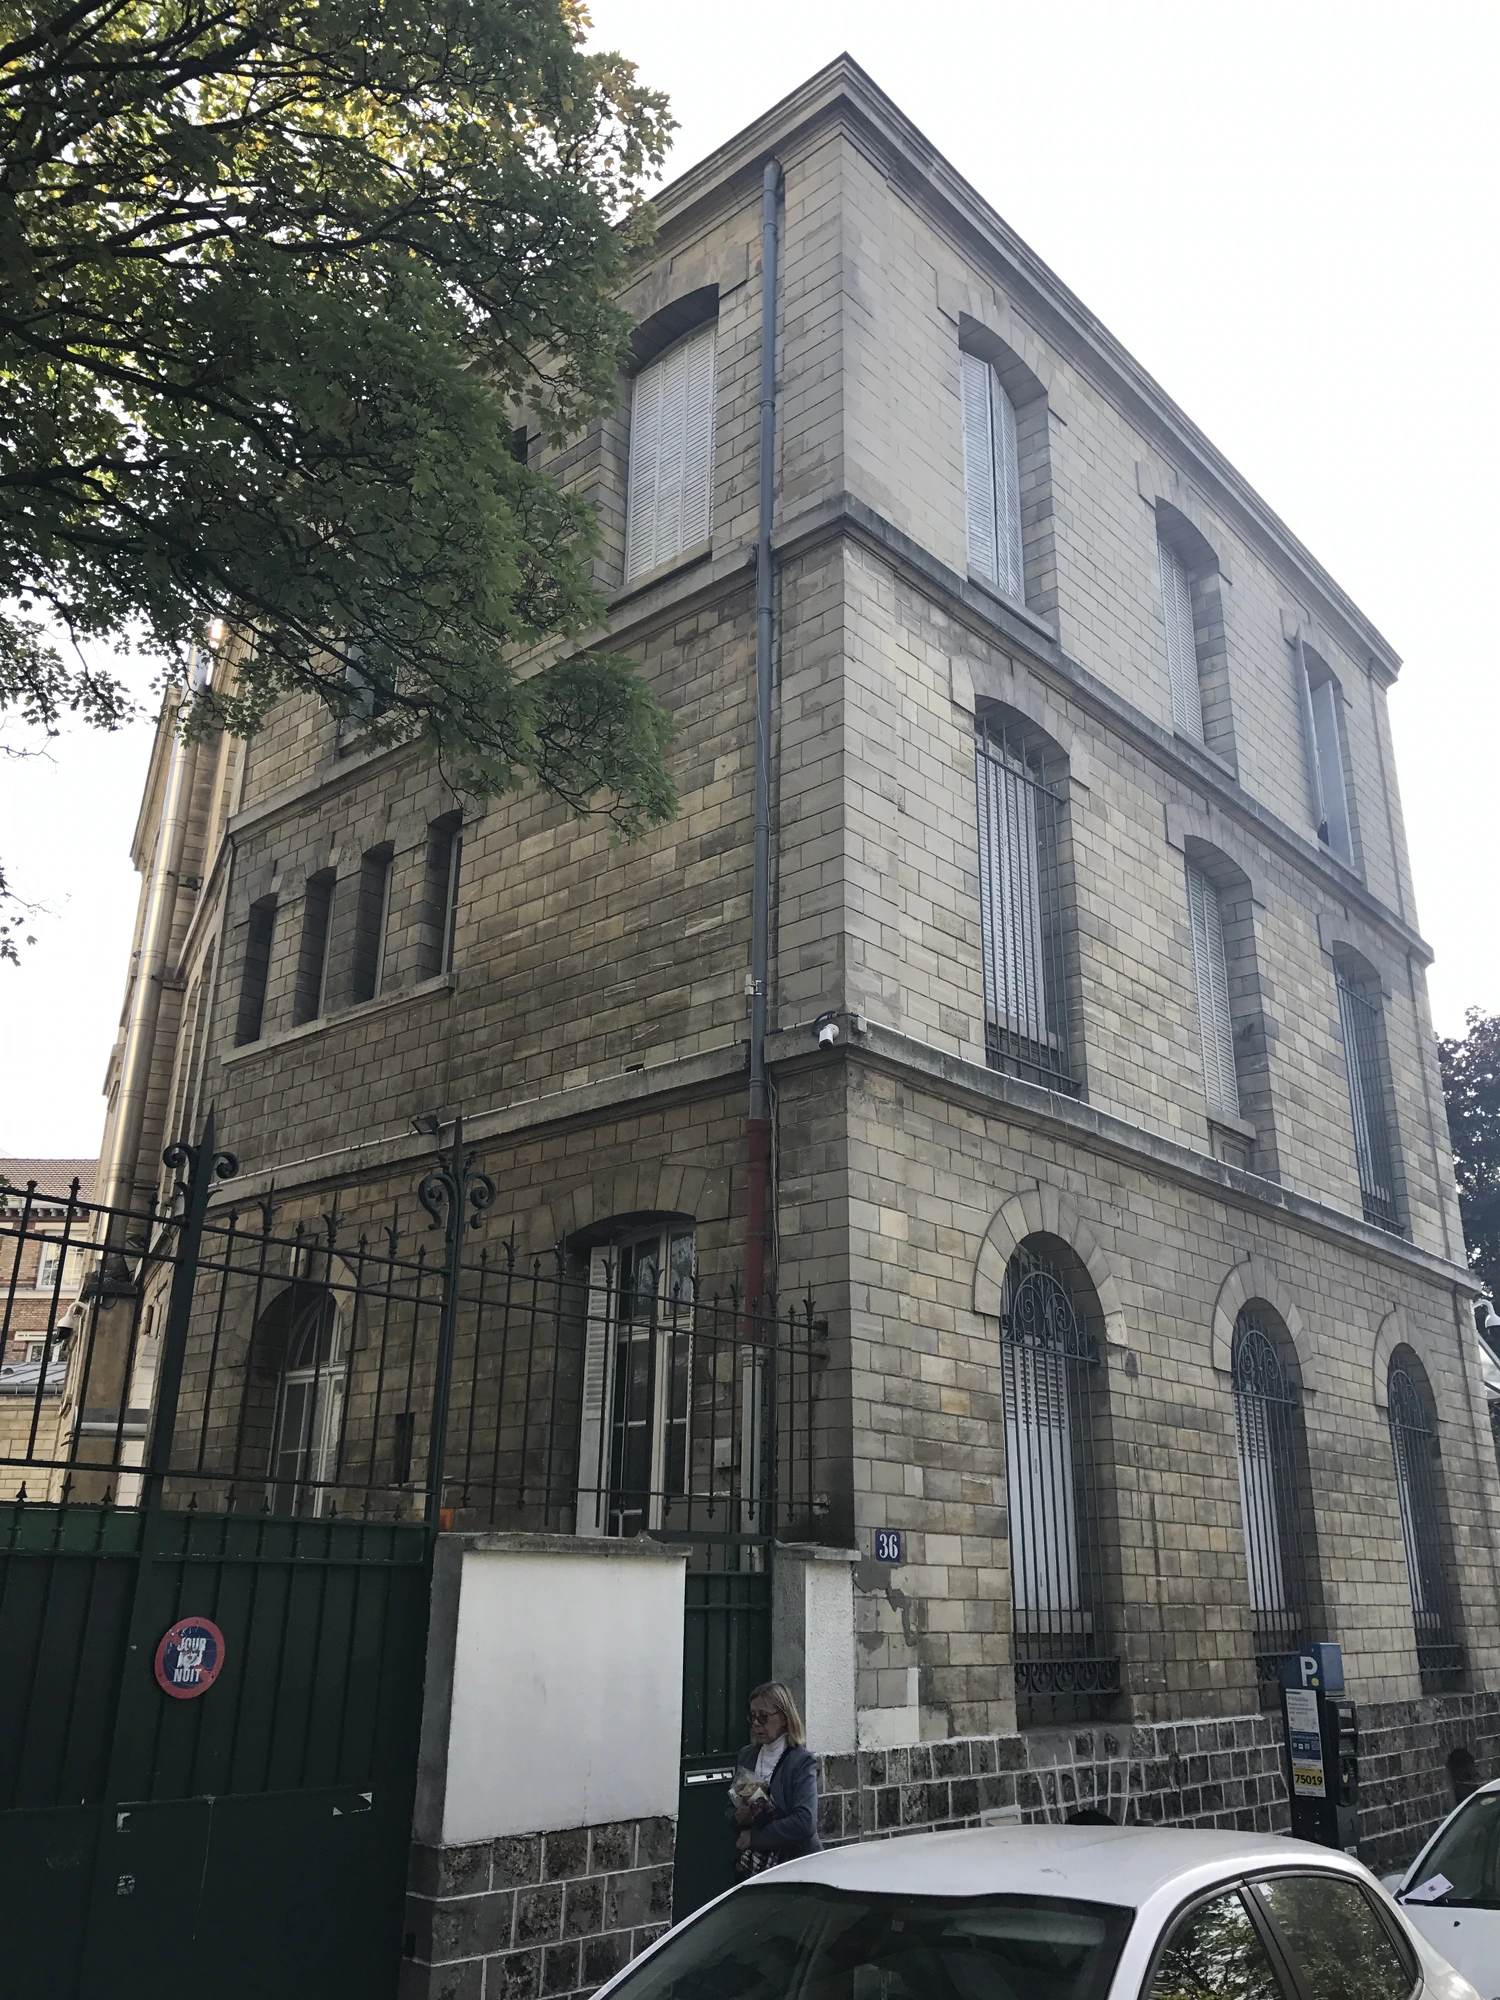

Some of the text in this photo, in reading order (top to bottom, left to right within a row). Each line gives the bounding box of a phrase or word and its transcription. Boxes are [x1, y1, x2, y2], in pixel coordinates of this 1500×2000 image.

[879, 1533, 898, 1558] 36
[177, 1637, 207, 1651] JOUR
[173, 1668, 202, 1682] NUIT
[1299, 1656, 1318, 1686] P
[1294, 1773, 1323, 1786] 75019
